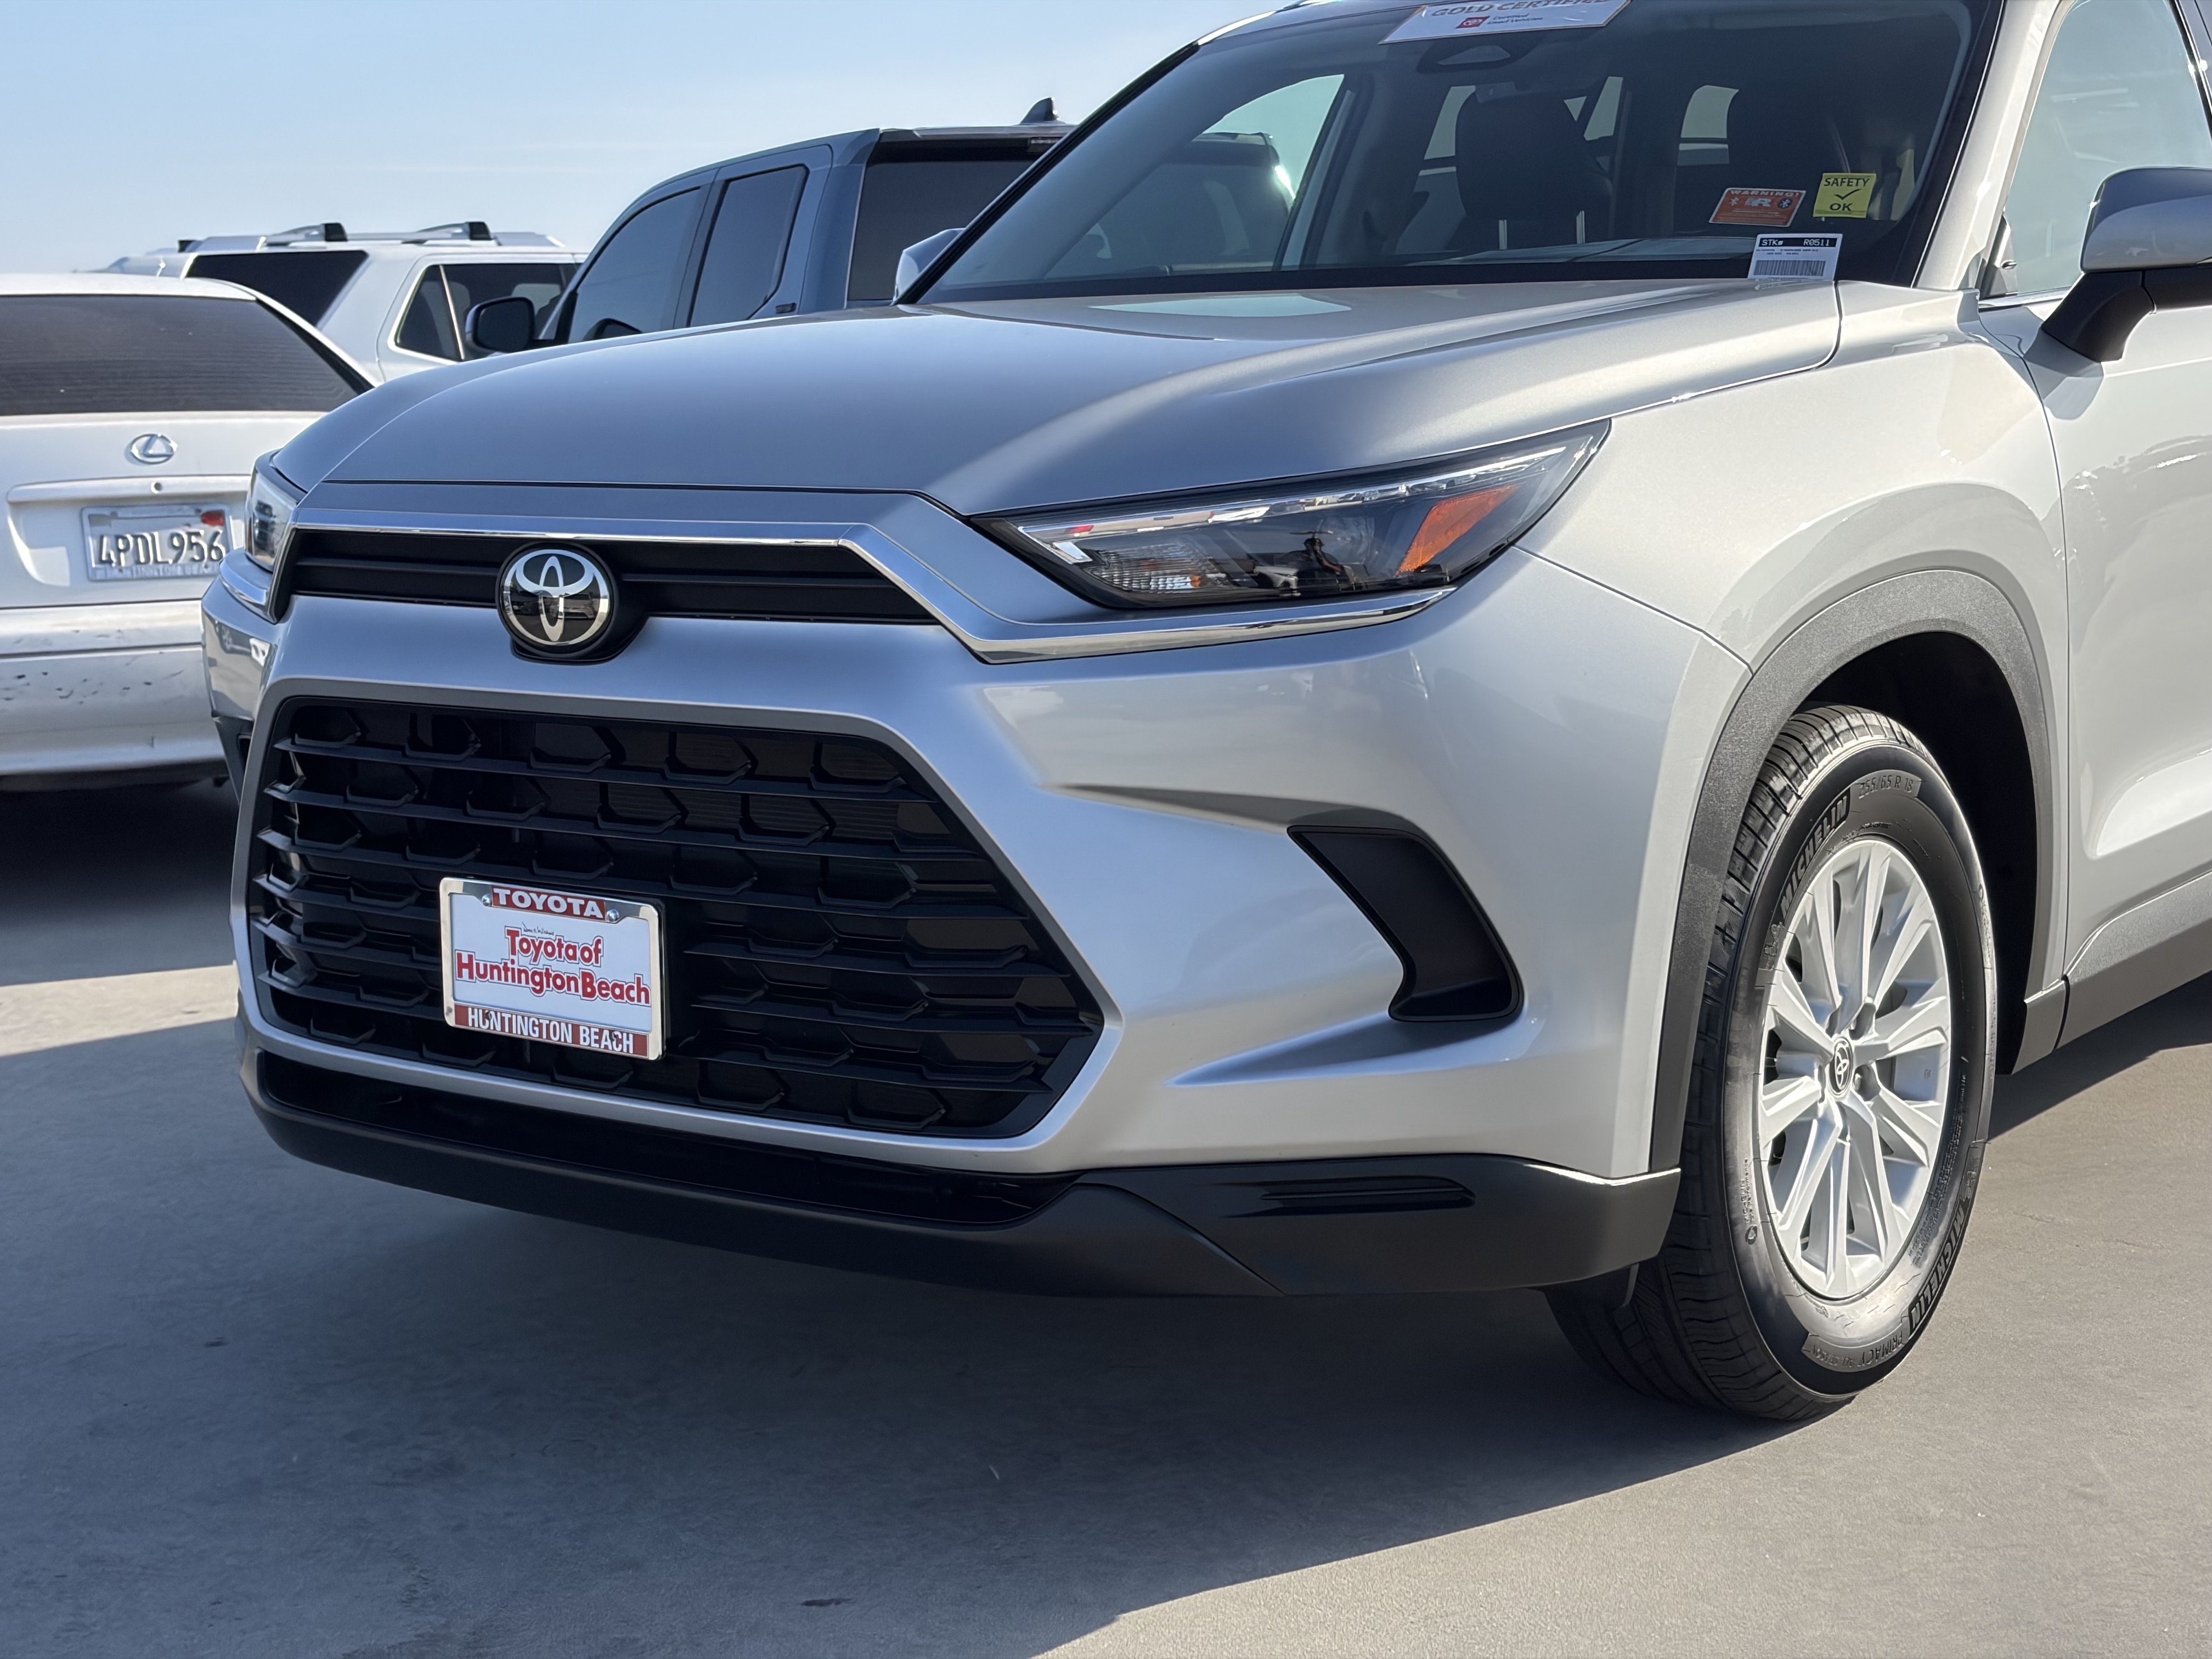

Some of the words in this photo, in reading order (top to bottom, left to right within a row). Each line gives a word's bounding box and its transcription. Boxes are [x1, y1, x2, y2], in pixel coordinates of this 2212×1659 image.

[1431, 4, 1493, 16] GOLD
[1824, 177, 1870, 187] SAFETY
[1830, 202, 1852, 212] OK
[99, 529, 225, 567] 4PDL956
[1781, 796, 1847, 919] MICHELIN
[494, 888, 603, 919] TOYOTA
[507, 929, 579, 964] Toyota
[580, 937, 602, 964] of
[456, 952, 578, 994] Huntington
[581, 971, 650, 1004] Beach
[468, 1007, 572, 1043] HUNTINGTON
[579, 1025, 633, 1054] BEACH
[1911, 1205, 1965, 1329] MICHELIN
